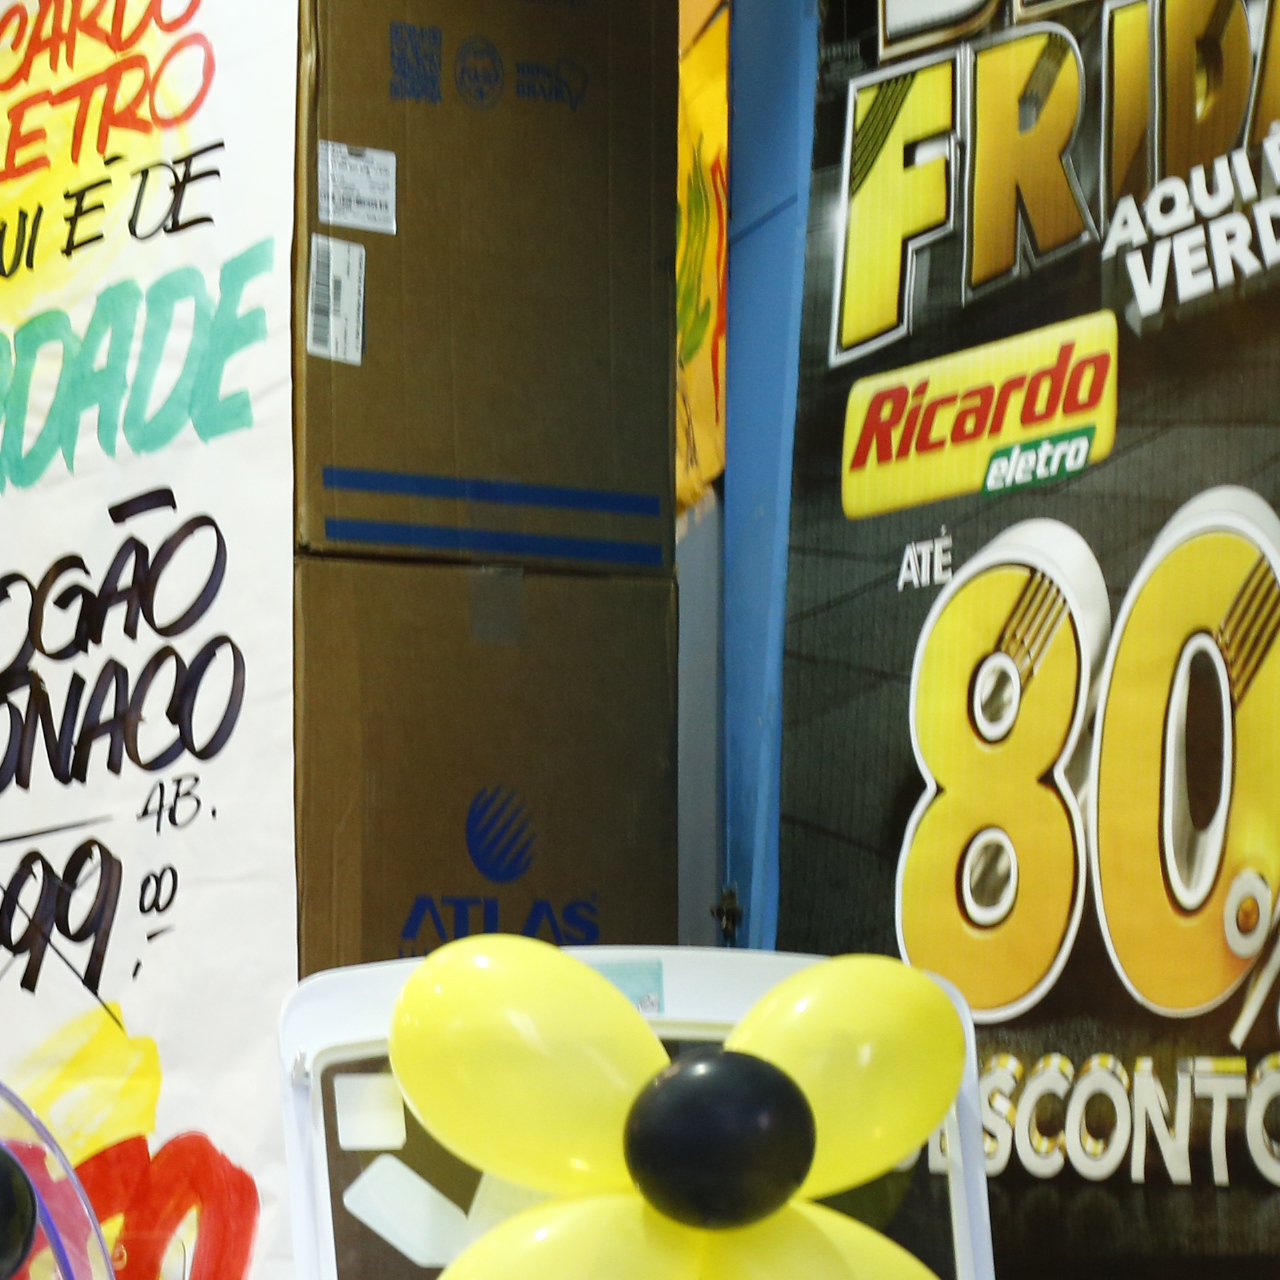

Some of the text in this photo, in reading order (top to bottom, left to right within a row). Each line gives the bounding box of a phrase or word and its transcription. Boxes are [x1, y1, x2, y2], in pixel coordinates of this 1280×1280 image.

[129, 140, 225, 240] DE
[1103, 148, 1257, 258] AQUI
[850, 341, 1110, 473] Ricardo
[986, 433, 1089, 492] eletro
[898, 526, 954, 592] ATÉ
[400, 892, 601, 945] ATLAS
[900, 1051, 1280, 1187] SCONTO
